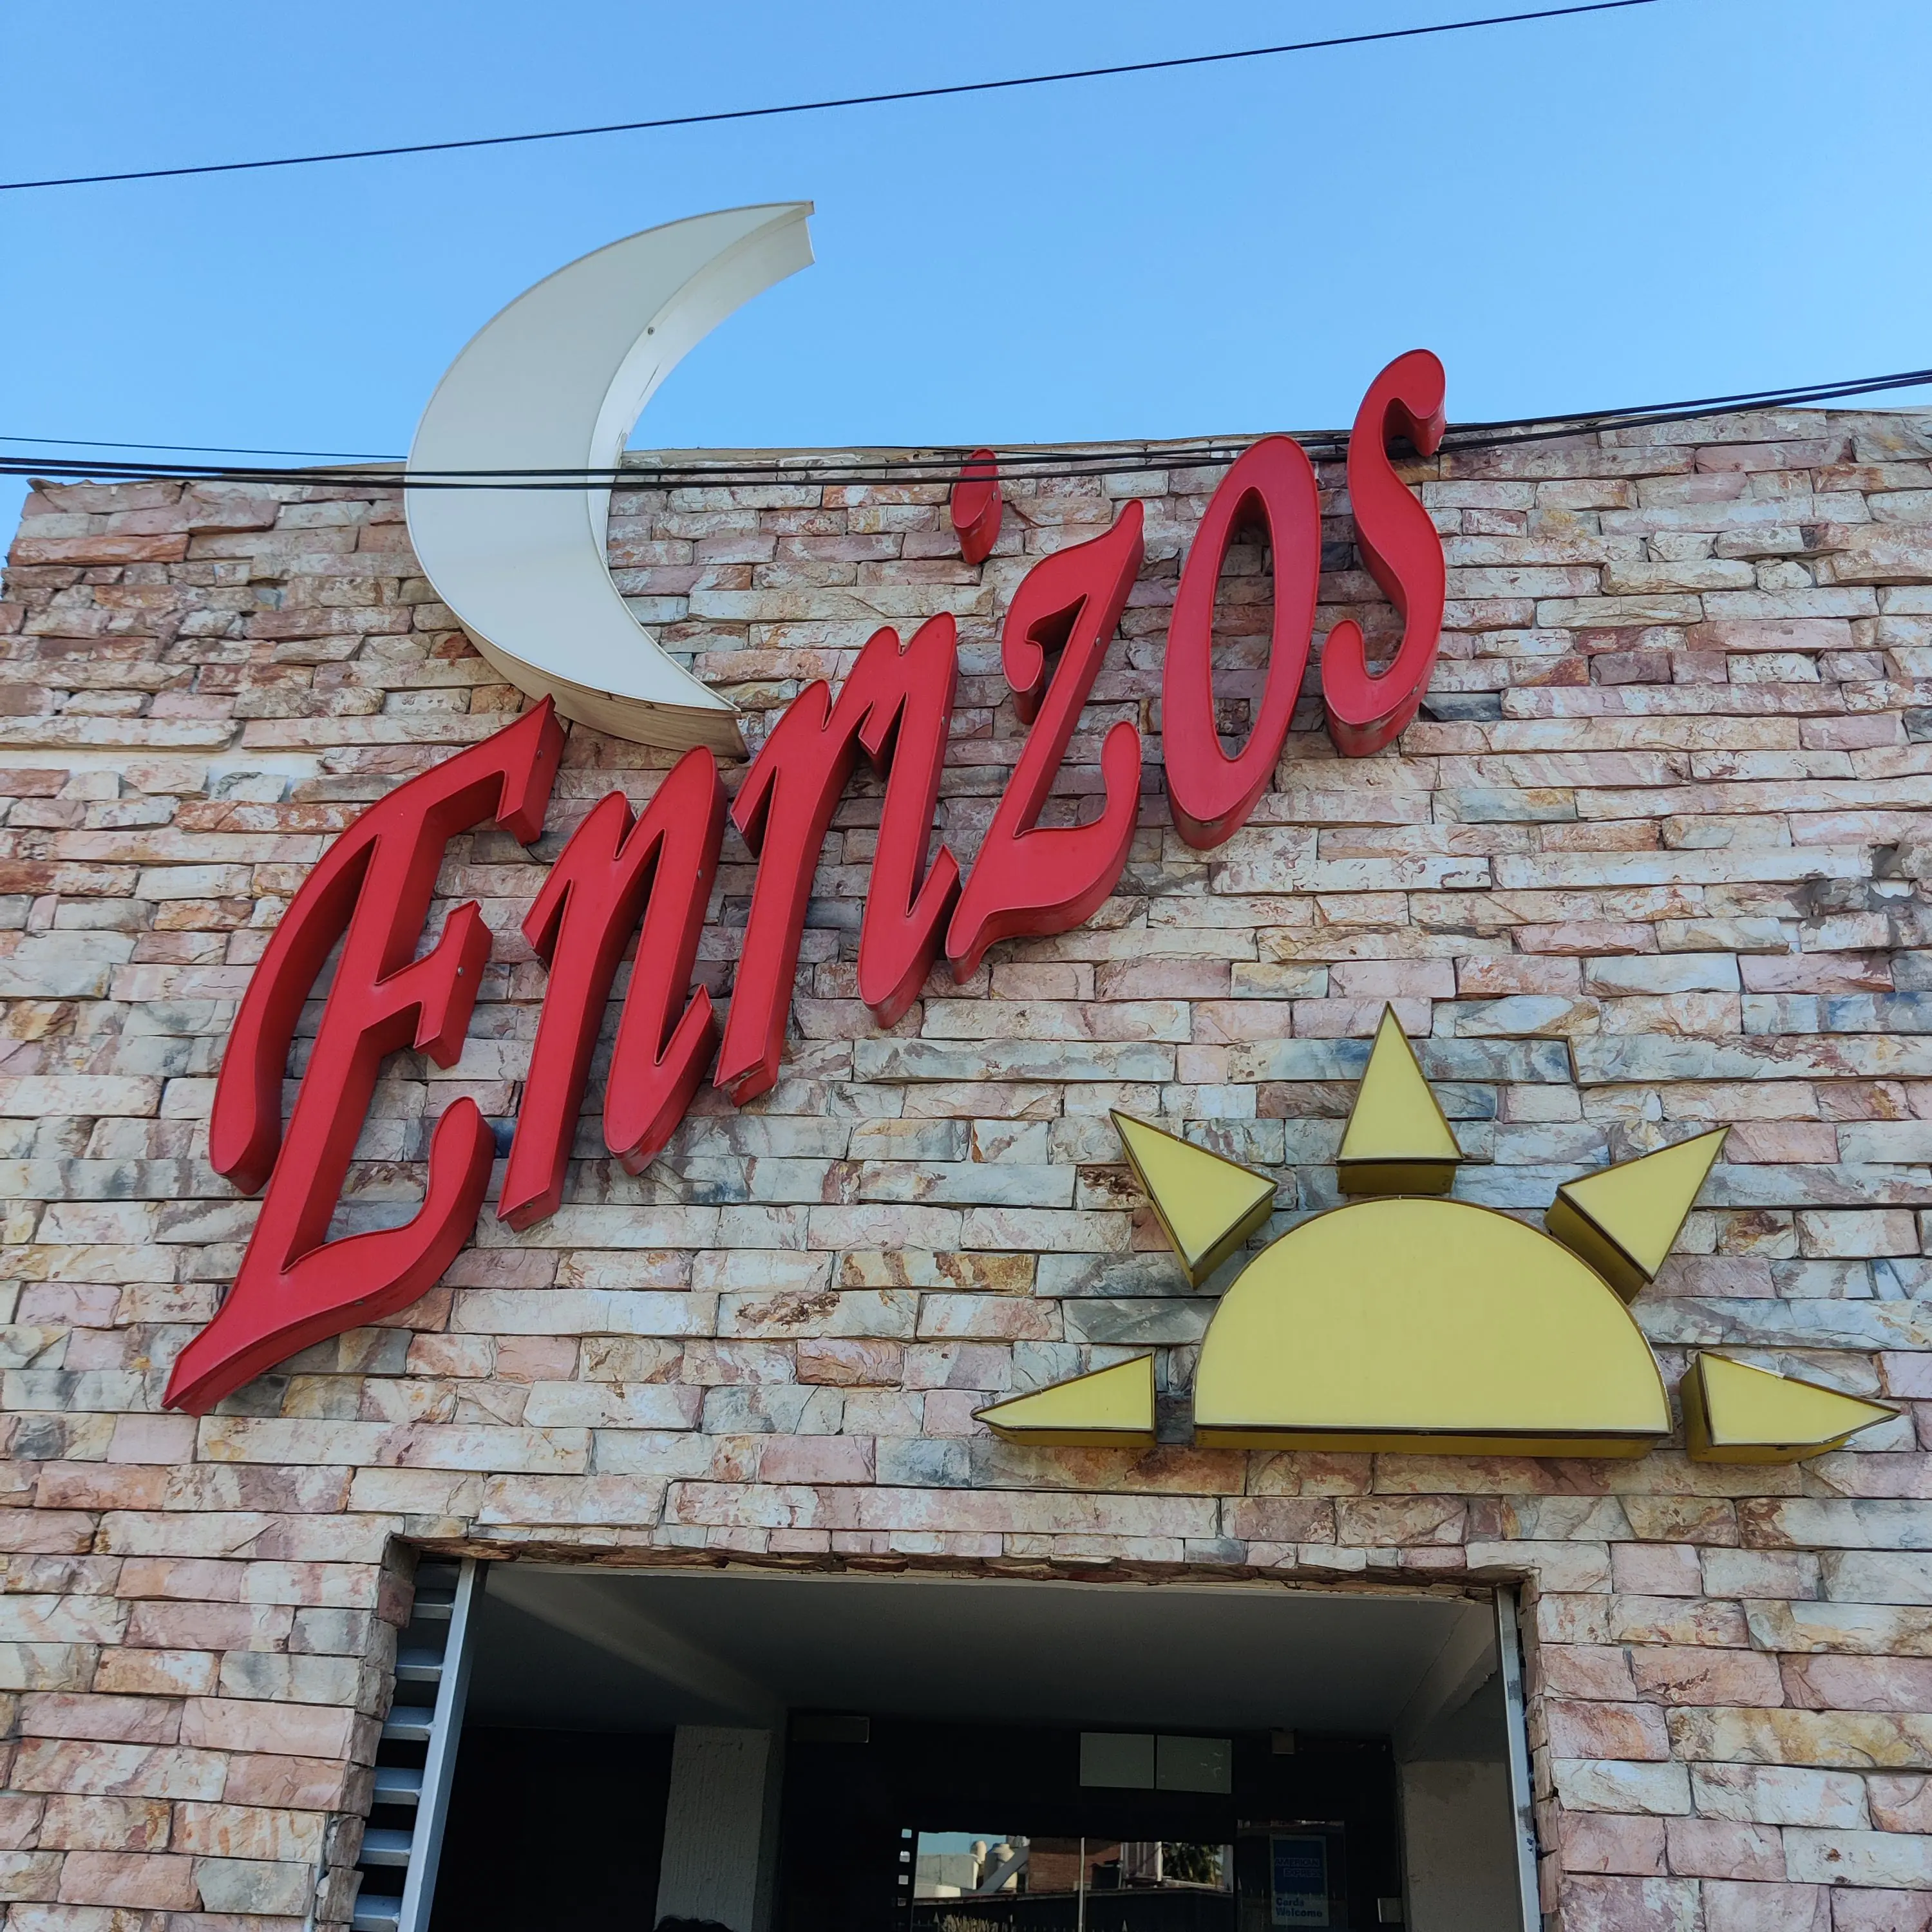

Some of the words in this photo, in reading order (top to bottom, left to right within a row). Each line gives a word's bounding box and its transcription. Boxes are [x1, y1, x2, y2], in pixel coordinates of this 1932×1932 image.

[1274, 1857, 1320, 1867] AMERICAN
[1283, 1868, 1322, 1877] EXPRESS
[1276, 1897, 1304, 1906] Cards
[1276, 1907, 1323, 1917] Welcome
